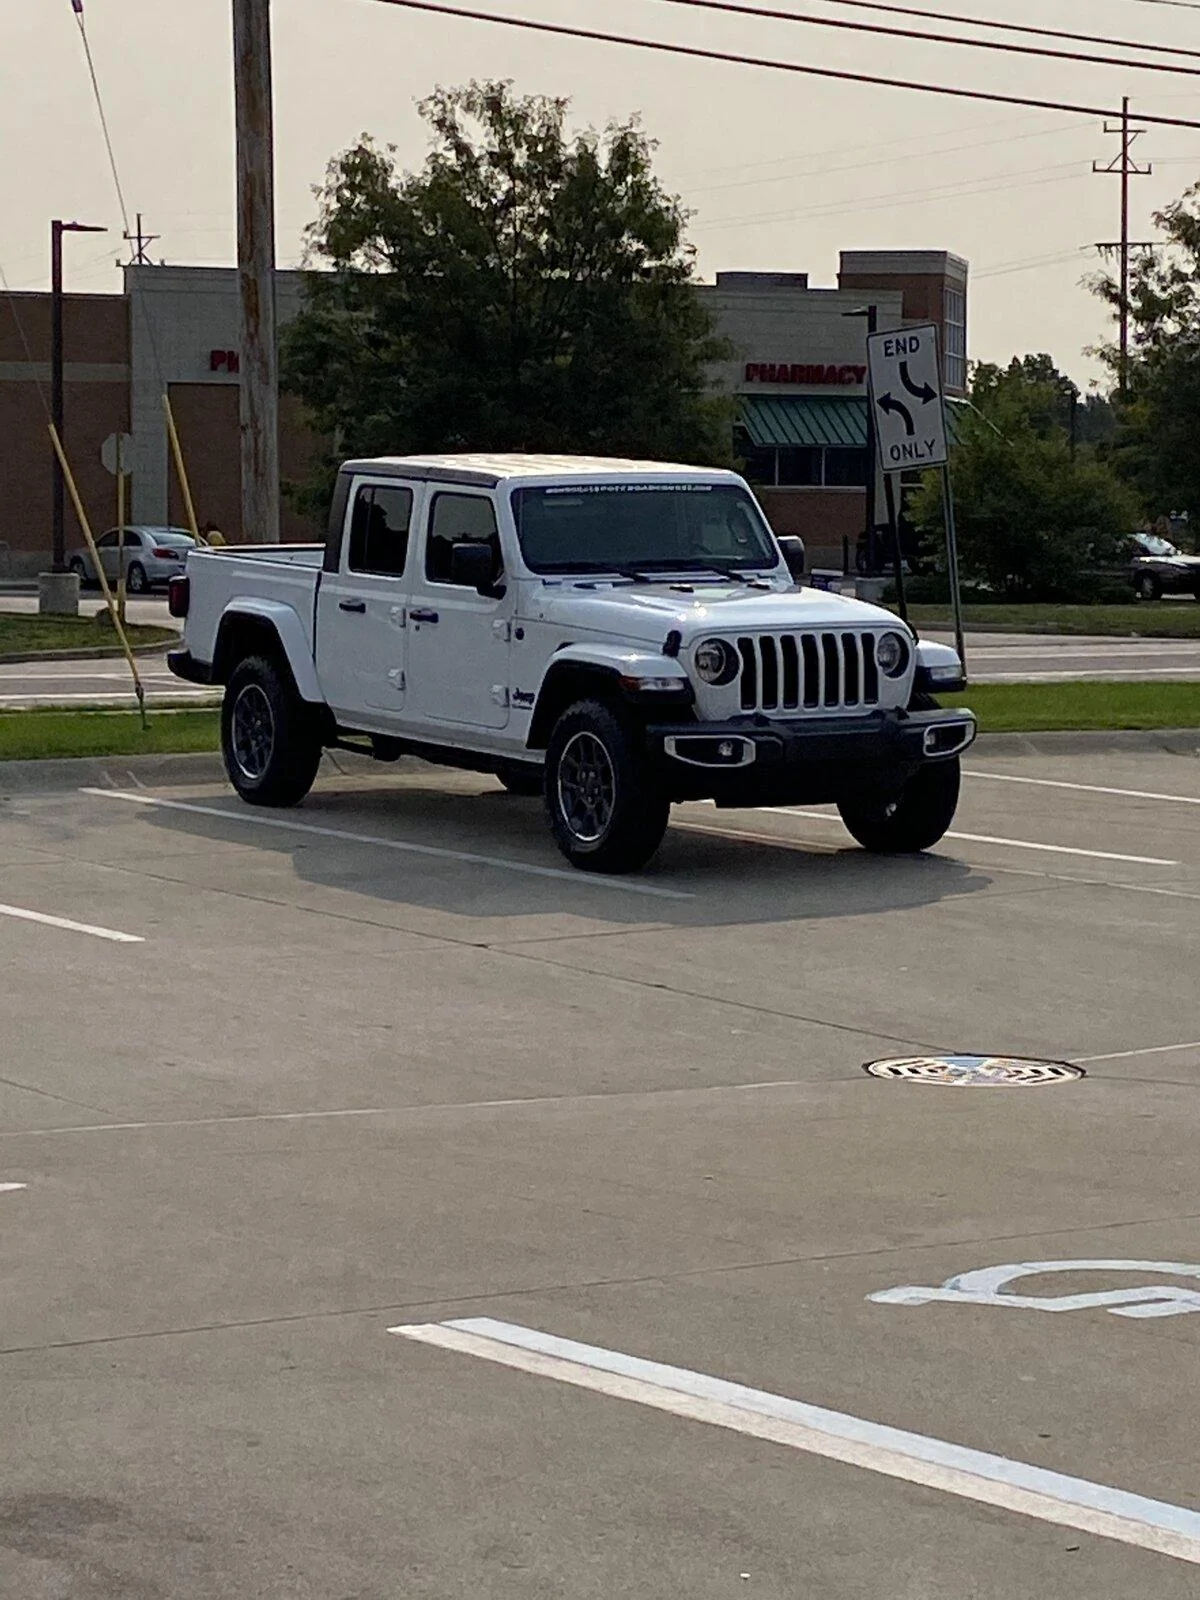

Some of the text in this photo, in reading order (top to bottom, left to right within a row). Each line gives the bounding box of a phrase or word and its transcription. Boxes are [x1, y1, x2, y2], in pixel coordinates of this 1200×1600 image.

[884, 336, 919, 357] END
[745, 363, 866, 384] PHARMACY
[889, 439, 935, 461] ONLY
